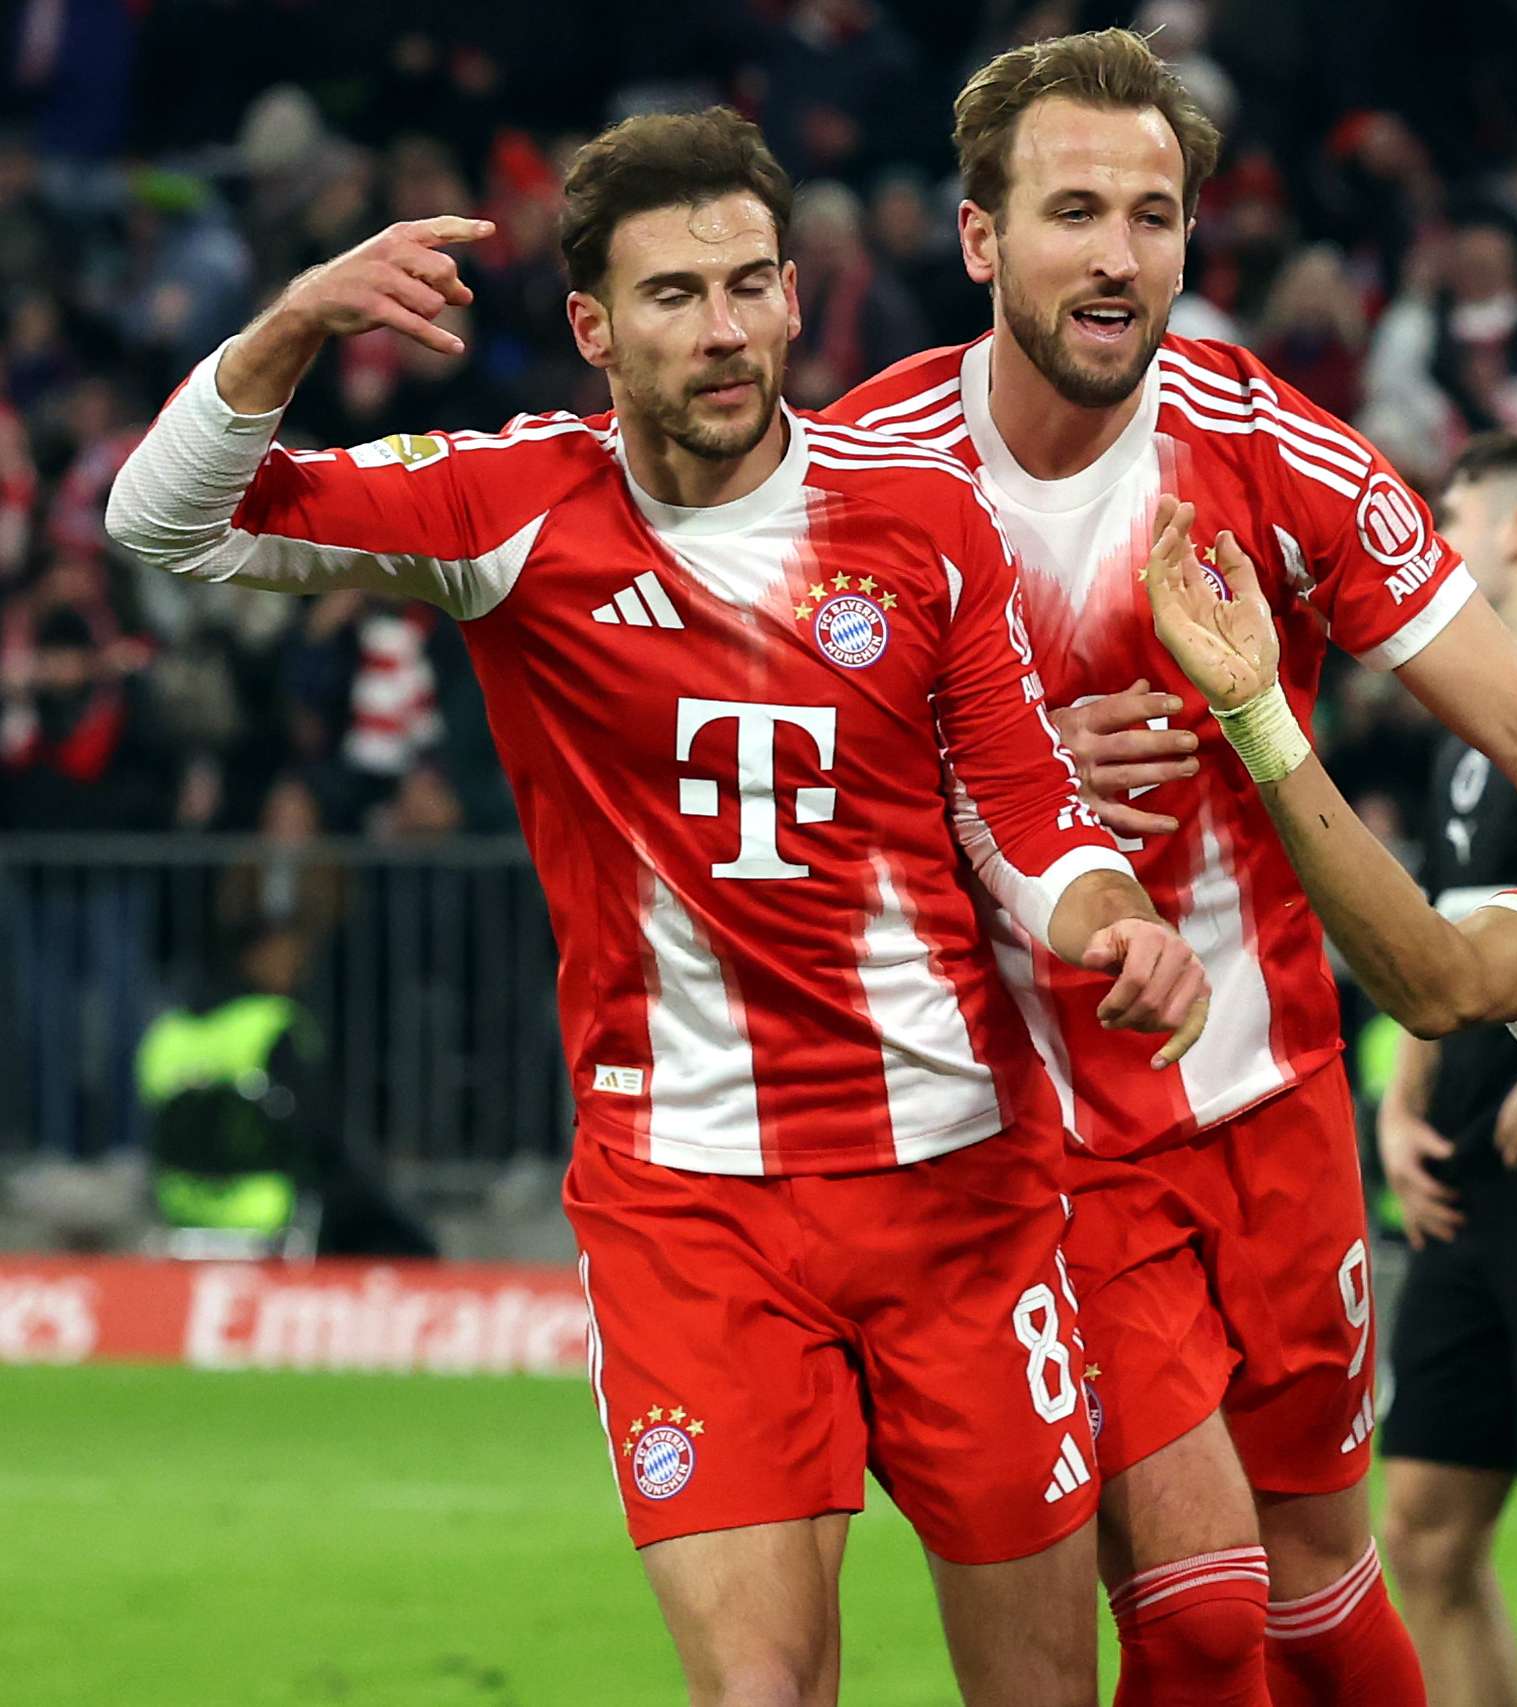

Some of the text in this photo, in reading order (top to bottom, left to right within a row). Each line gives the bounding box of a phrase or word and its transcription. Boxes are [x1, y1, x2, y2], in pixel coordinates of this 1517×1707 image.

[820, 600, 880, 631] FC BAYERN
[676, 697, 837, 880] T
[184, 1264, 590, 1373] Emirate
[1012, 1283, 1078, 1424] 8
[1339, 1238, 1371, 1380] 9
[645, 1431, 687, 1453] BAYERN
